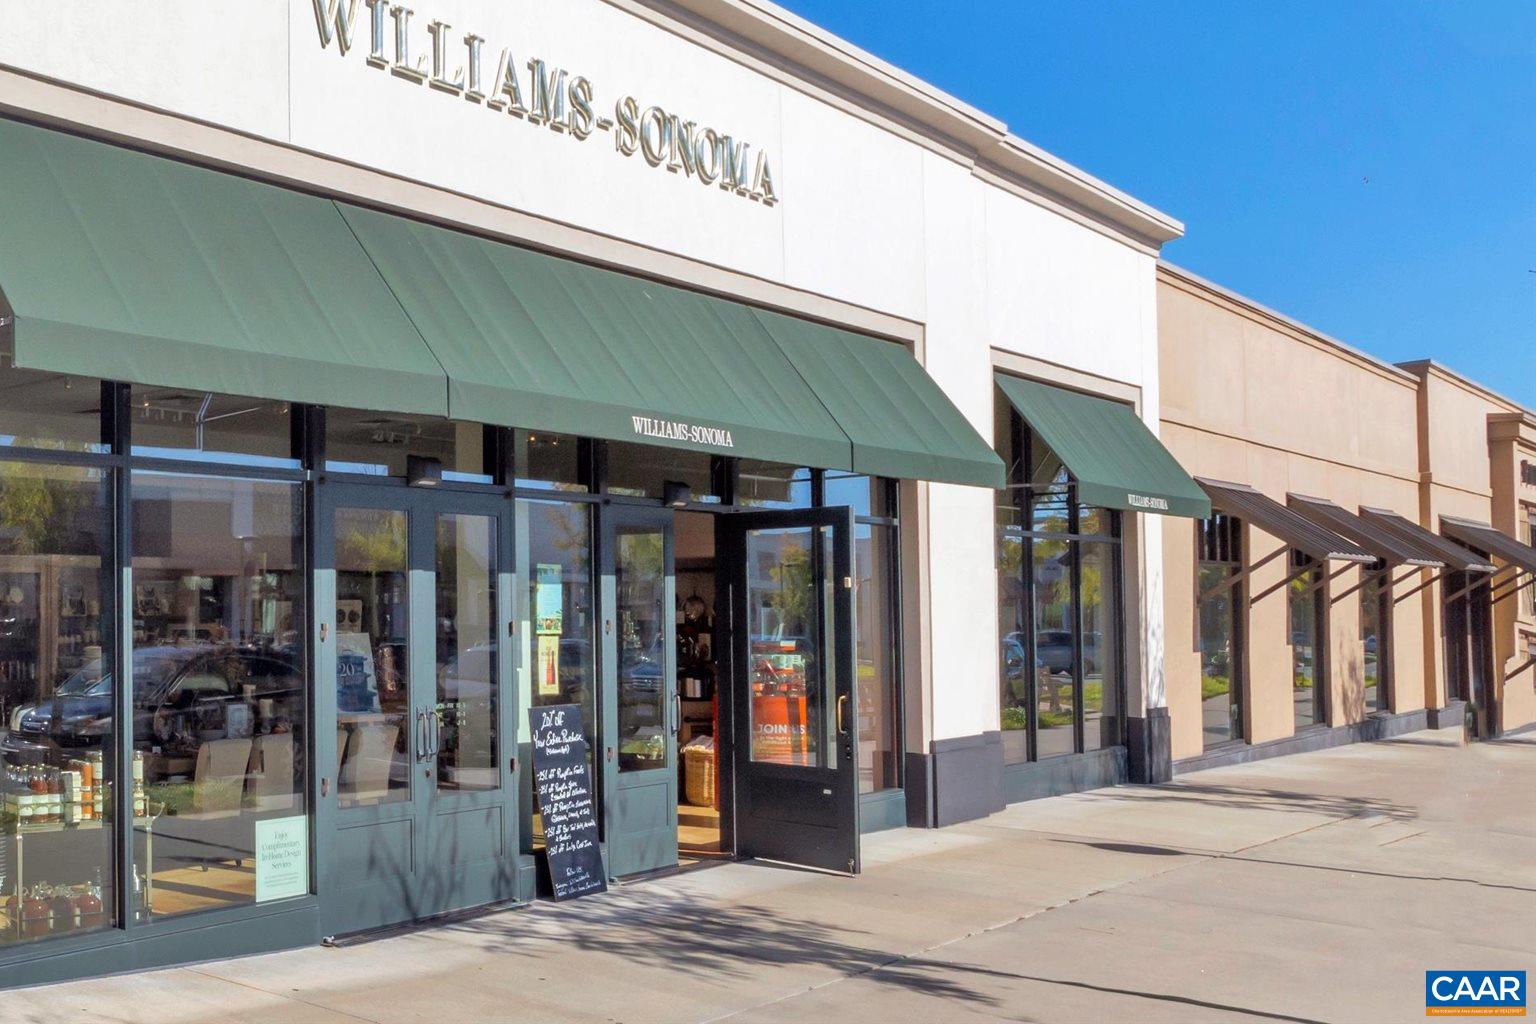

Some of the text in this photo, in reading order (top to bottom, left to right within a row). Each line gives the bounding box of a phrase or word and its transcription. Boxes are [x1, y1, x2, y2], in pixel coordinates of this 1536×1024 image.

[631, 416, 734, 448] WILLIAMS-SONOMA
[339, 663, 355, 677] 20
[758, 724, 787, 734] JOIN
